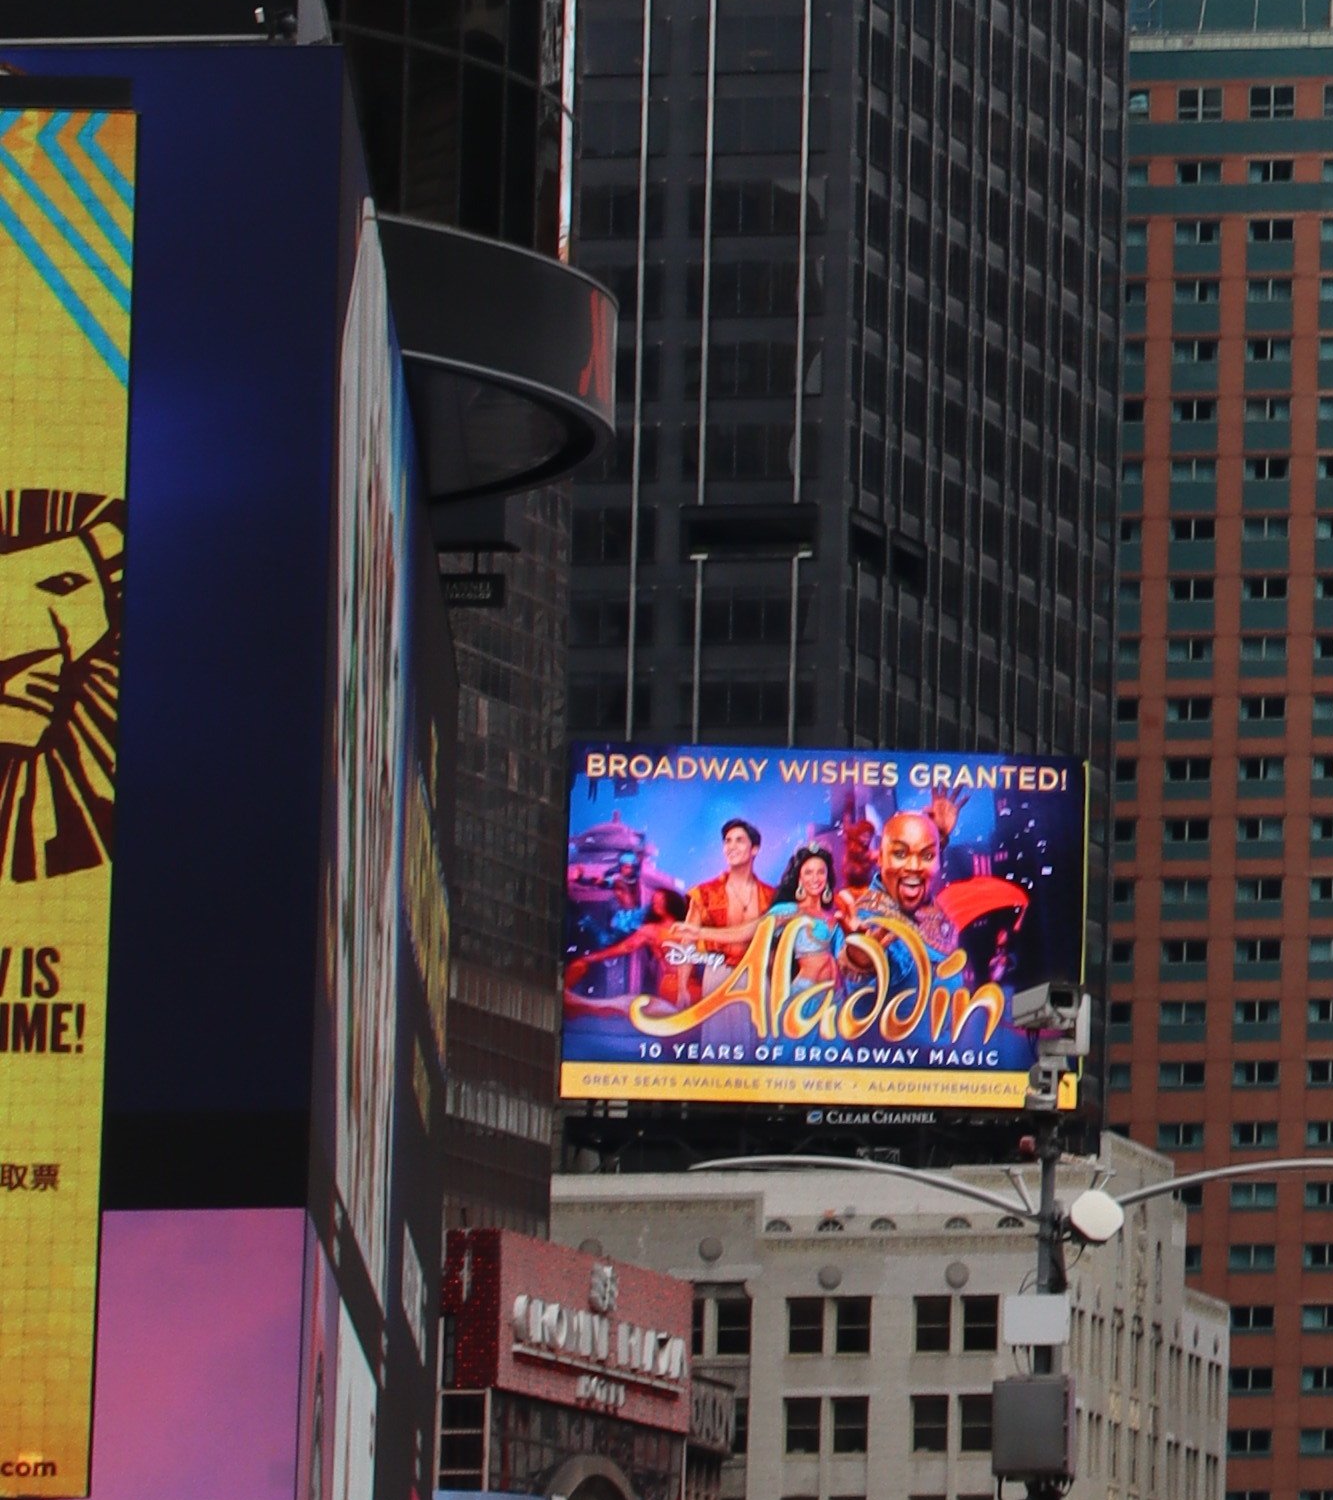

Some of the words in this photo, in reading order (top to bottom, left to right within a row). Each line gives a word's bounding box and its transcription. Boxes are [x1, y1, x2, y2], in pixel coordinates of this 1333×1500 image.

[586, 753, 769, 783] BROADWAY
[779, 759, 899, 787] WISHES
[909, 762, 1068, 793] GRANTED!
[21, 947, 60, 999] IS
[630, 915, 1005, 1047] Aladdin
[638, 1042, 661, 1059] 10
[672, 1043, 745, 1061] YEARS
[755, 1044, 785, 1061] OF
[795, 1045, 919, 1065] BROADWAY
[928, 1048, 999, 1067] MAGIC
[582, 1075, 628, 1087] GREAT
[634, 1076, 678, 1088] SEATS
[682, 1077, 759, 1090] AVAILABLE
[766, 1079, 797, 1091] THIS
[802, 1080, 842, 1092] WEEK
[826, 1111, 869, 1125] CLEAR
[872, 1110, 937, 1126] CHANNEL
